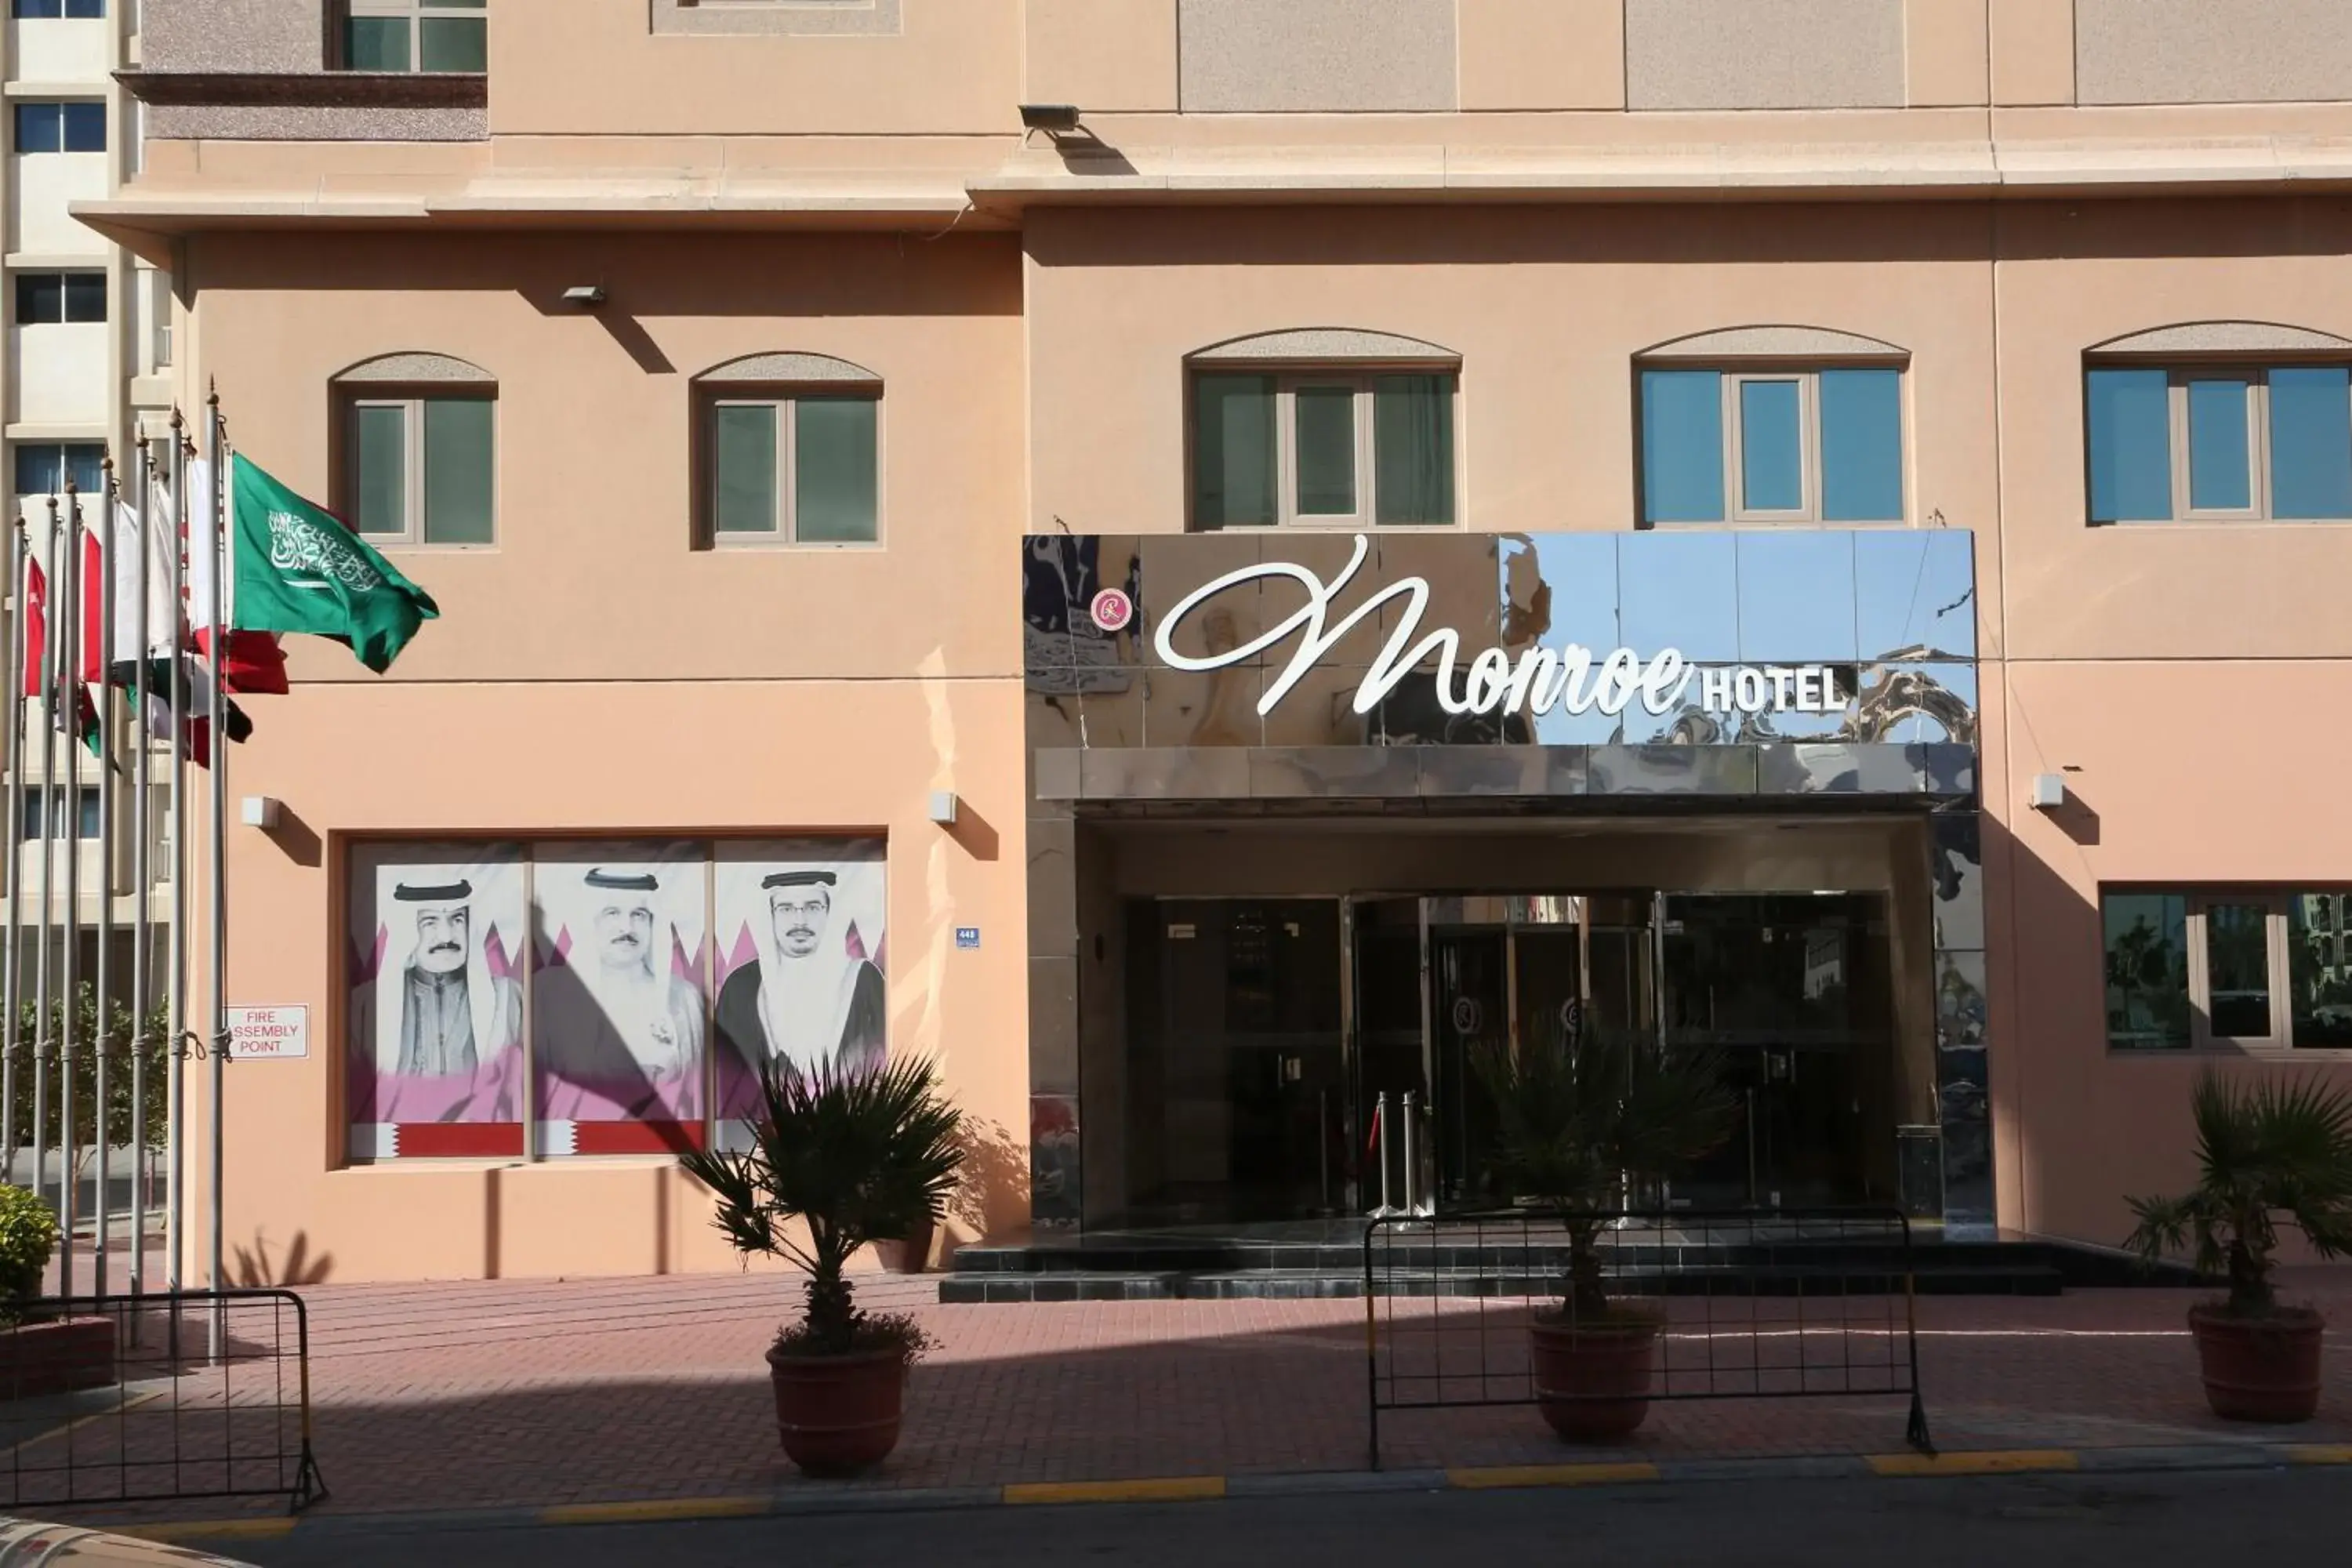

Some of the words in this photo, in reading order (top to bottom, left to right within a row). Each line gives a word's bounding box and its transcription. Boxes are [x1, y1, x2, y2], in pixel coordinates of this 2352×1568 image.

[1154, 534, 1692, 717] Monroe
[1702, 668, 1847, 713] HOTEL
[247, 1011, 275, 1022] FIRE
[230, 1025, 299, 1037] SSEMBLY
[241, 1041, 281, 1052] POINT
